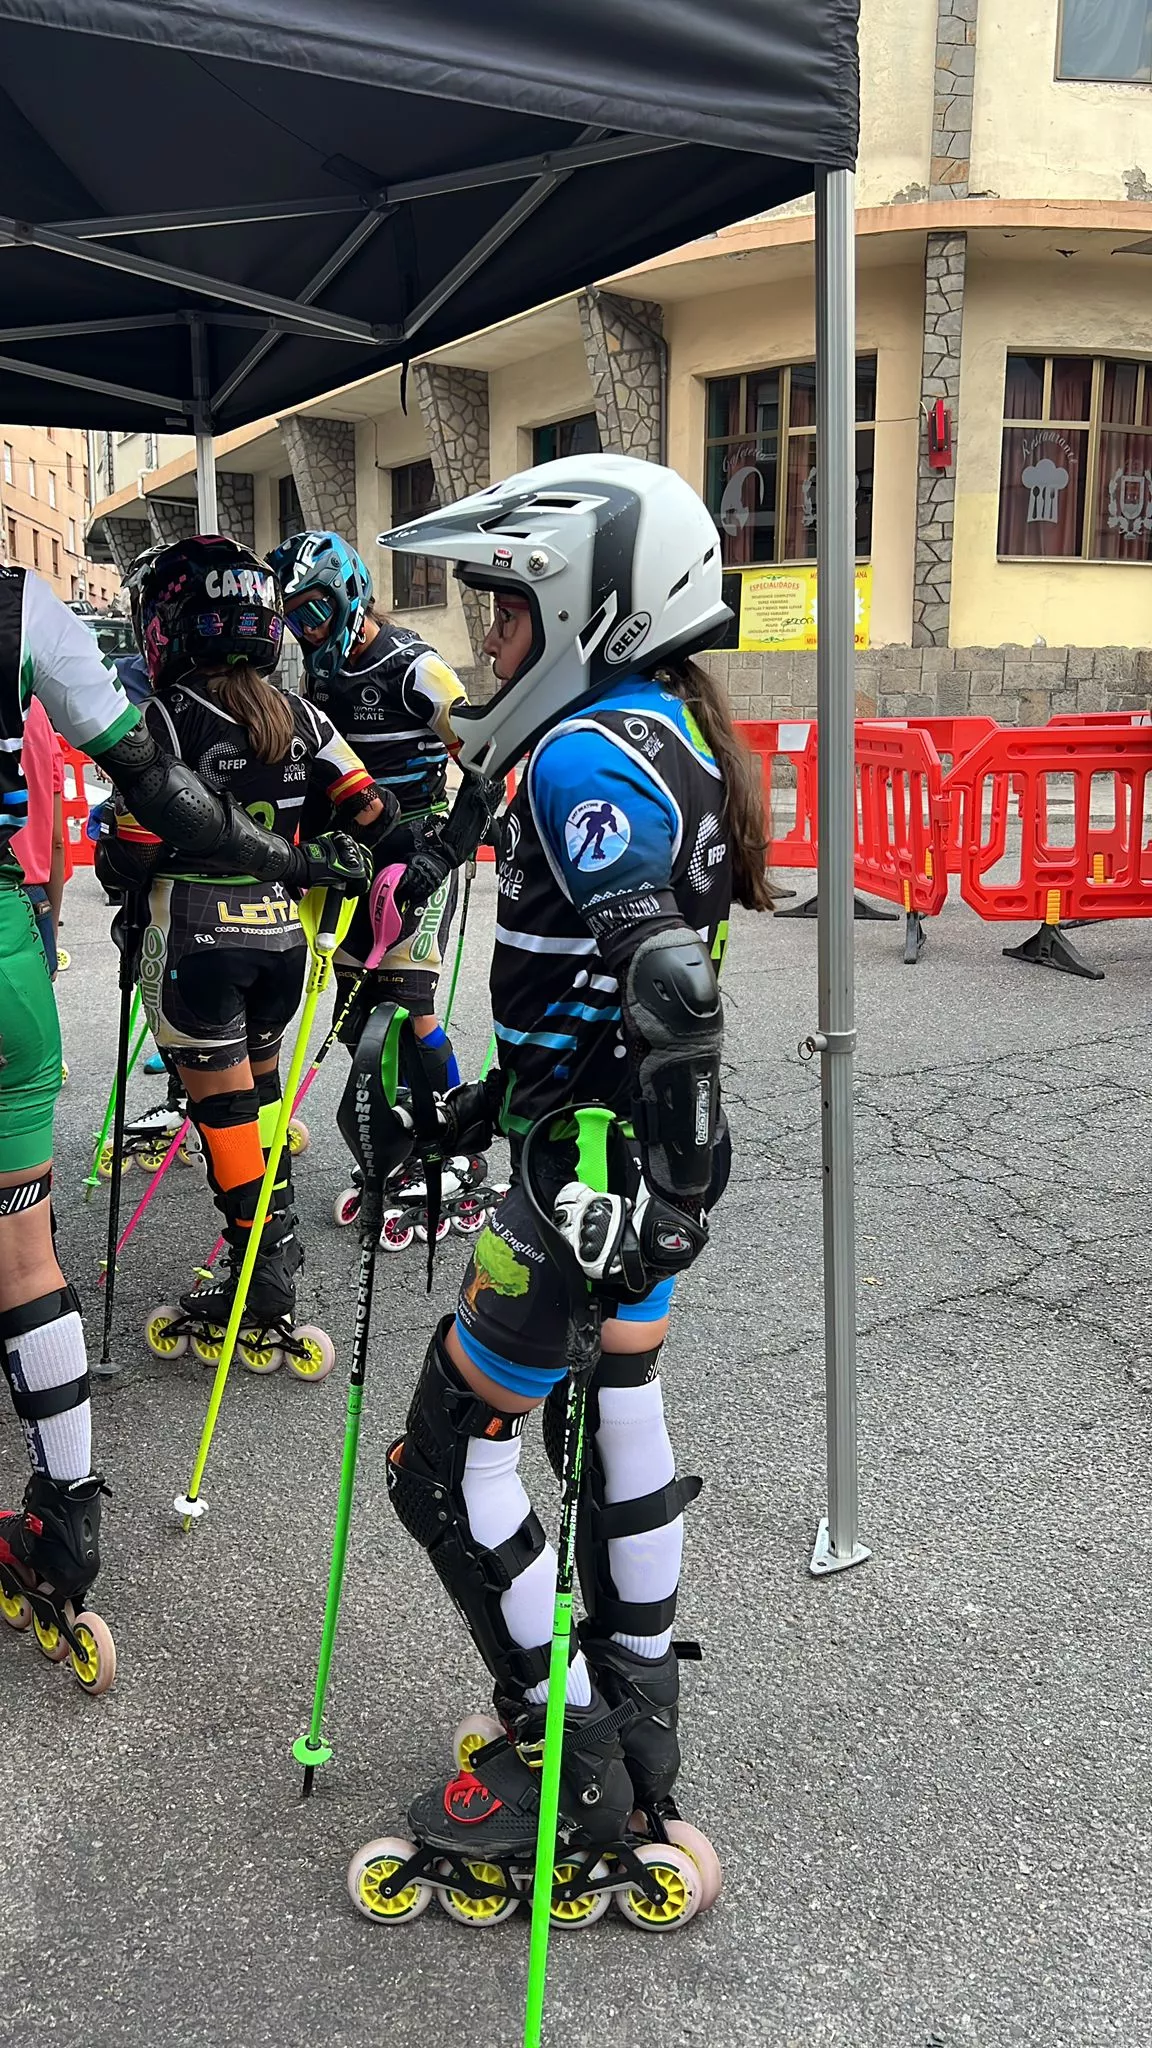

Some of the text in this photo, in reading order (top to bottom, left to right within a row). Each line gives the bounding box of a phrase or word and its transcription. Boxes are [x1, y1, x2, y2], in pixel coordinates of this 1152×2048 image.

[1022, 431, 1078, 463] Restaurante
[495, 559, 509, 567] MD
[749, 581, 800, 592] ESPECIALIDADES
[610, 619, 648, 658] BELL
[353, 712, 385, 720] SKATE
[647, 738, 665, 761] SKATE
[218, 759, 247, 770] RFEP
[283, 771, 306, 782] SKATE
[707, 843, 726, 867] RFEP
[500, 861, 524, 884] WOLD
[374, 883, 390, 924] LEKI
[355, 1072, 377, 1178] KOMPERDELL
[0, 1199, 9, 1215] OX
[500, 1228, 547, 1264] English
[351, 1249, 372, 1374] PERDELL
